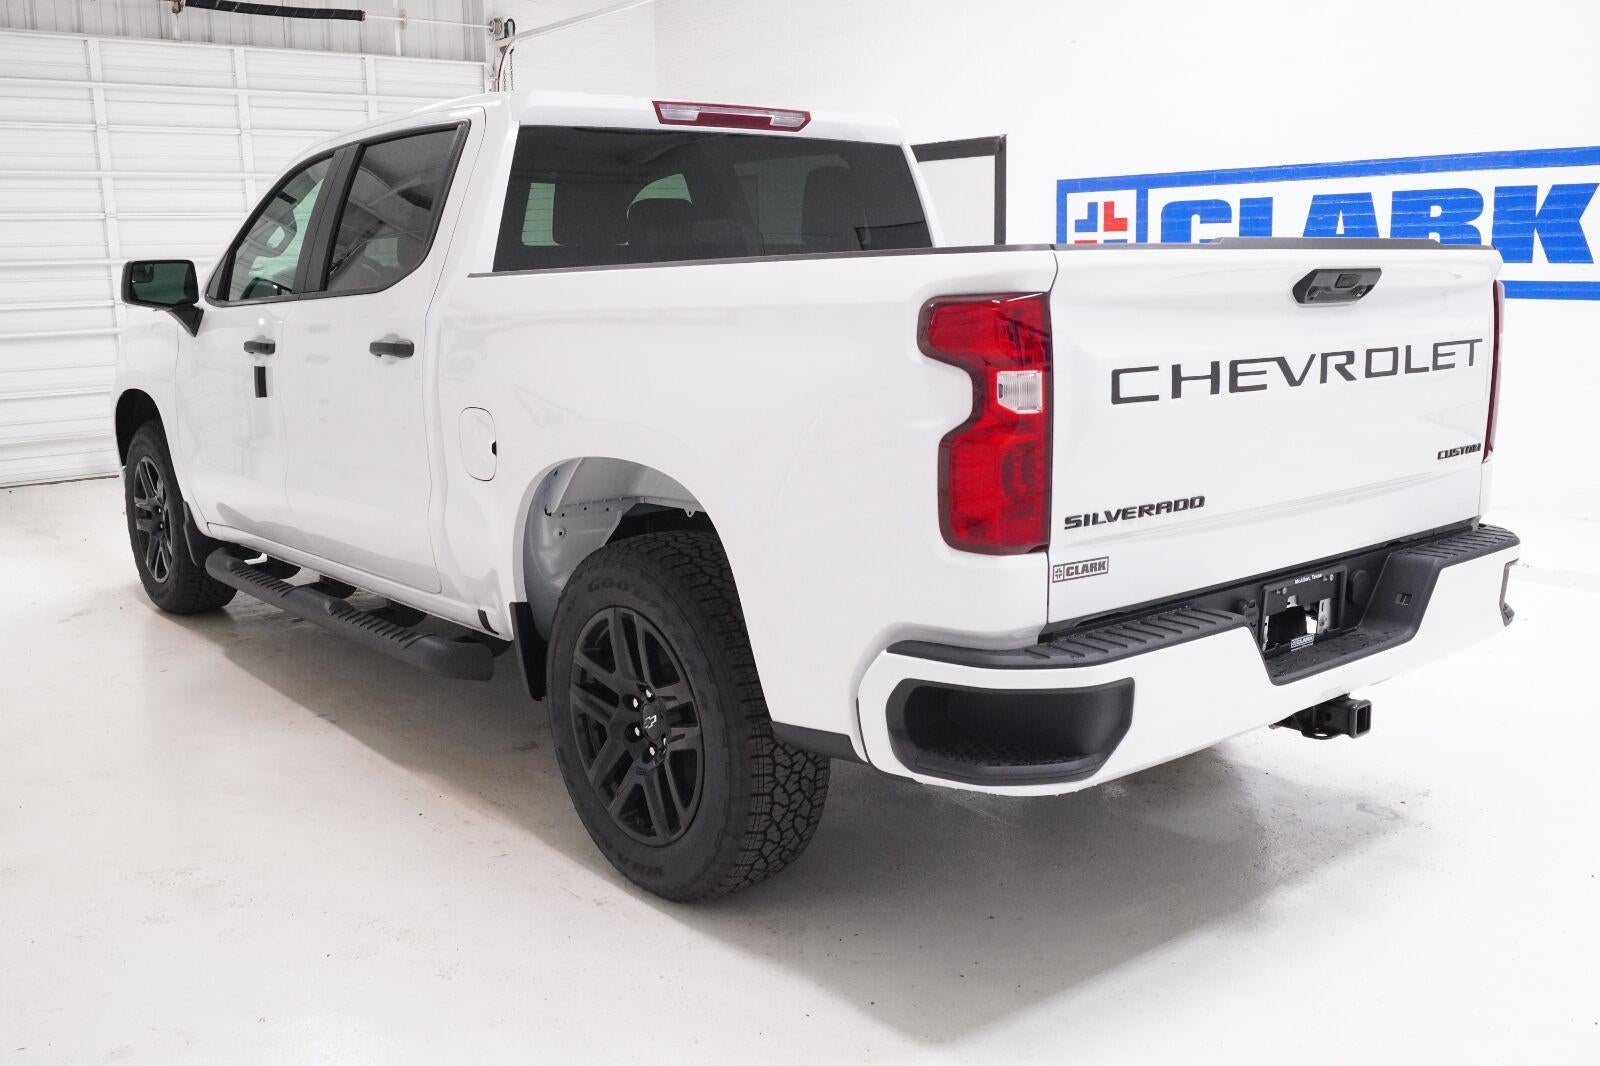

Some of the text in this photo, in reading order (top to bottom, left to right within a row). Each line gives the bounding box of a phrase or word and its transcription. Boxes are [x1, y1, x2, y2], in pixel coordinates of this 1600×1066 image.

[1110, 338, 1483, 405] CHEVROLET
[1437, 442, 1481, 460] CUSTOM
[1064, 495, 1206, 530] SILVERADO
[1065, 561, 1107, 577] CLARK
